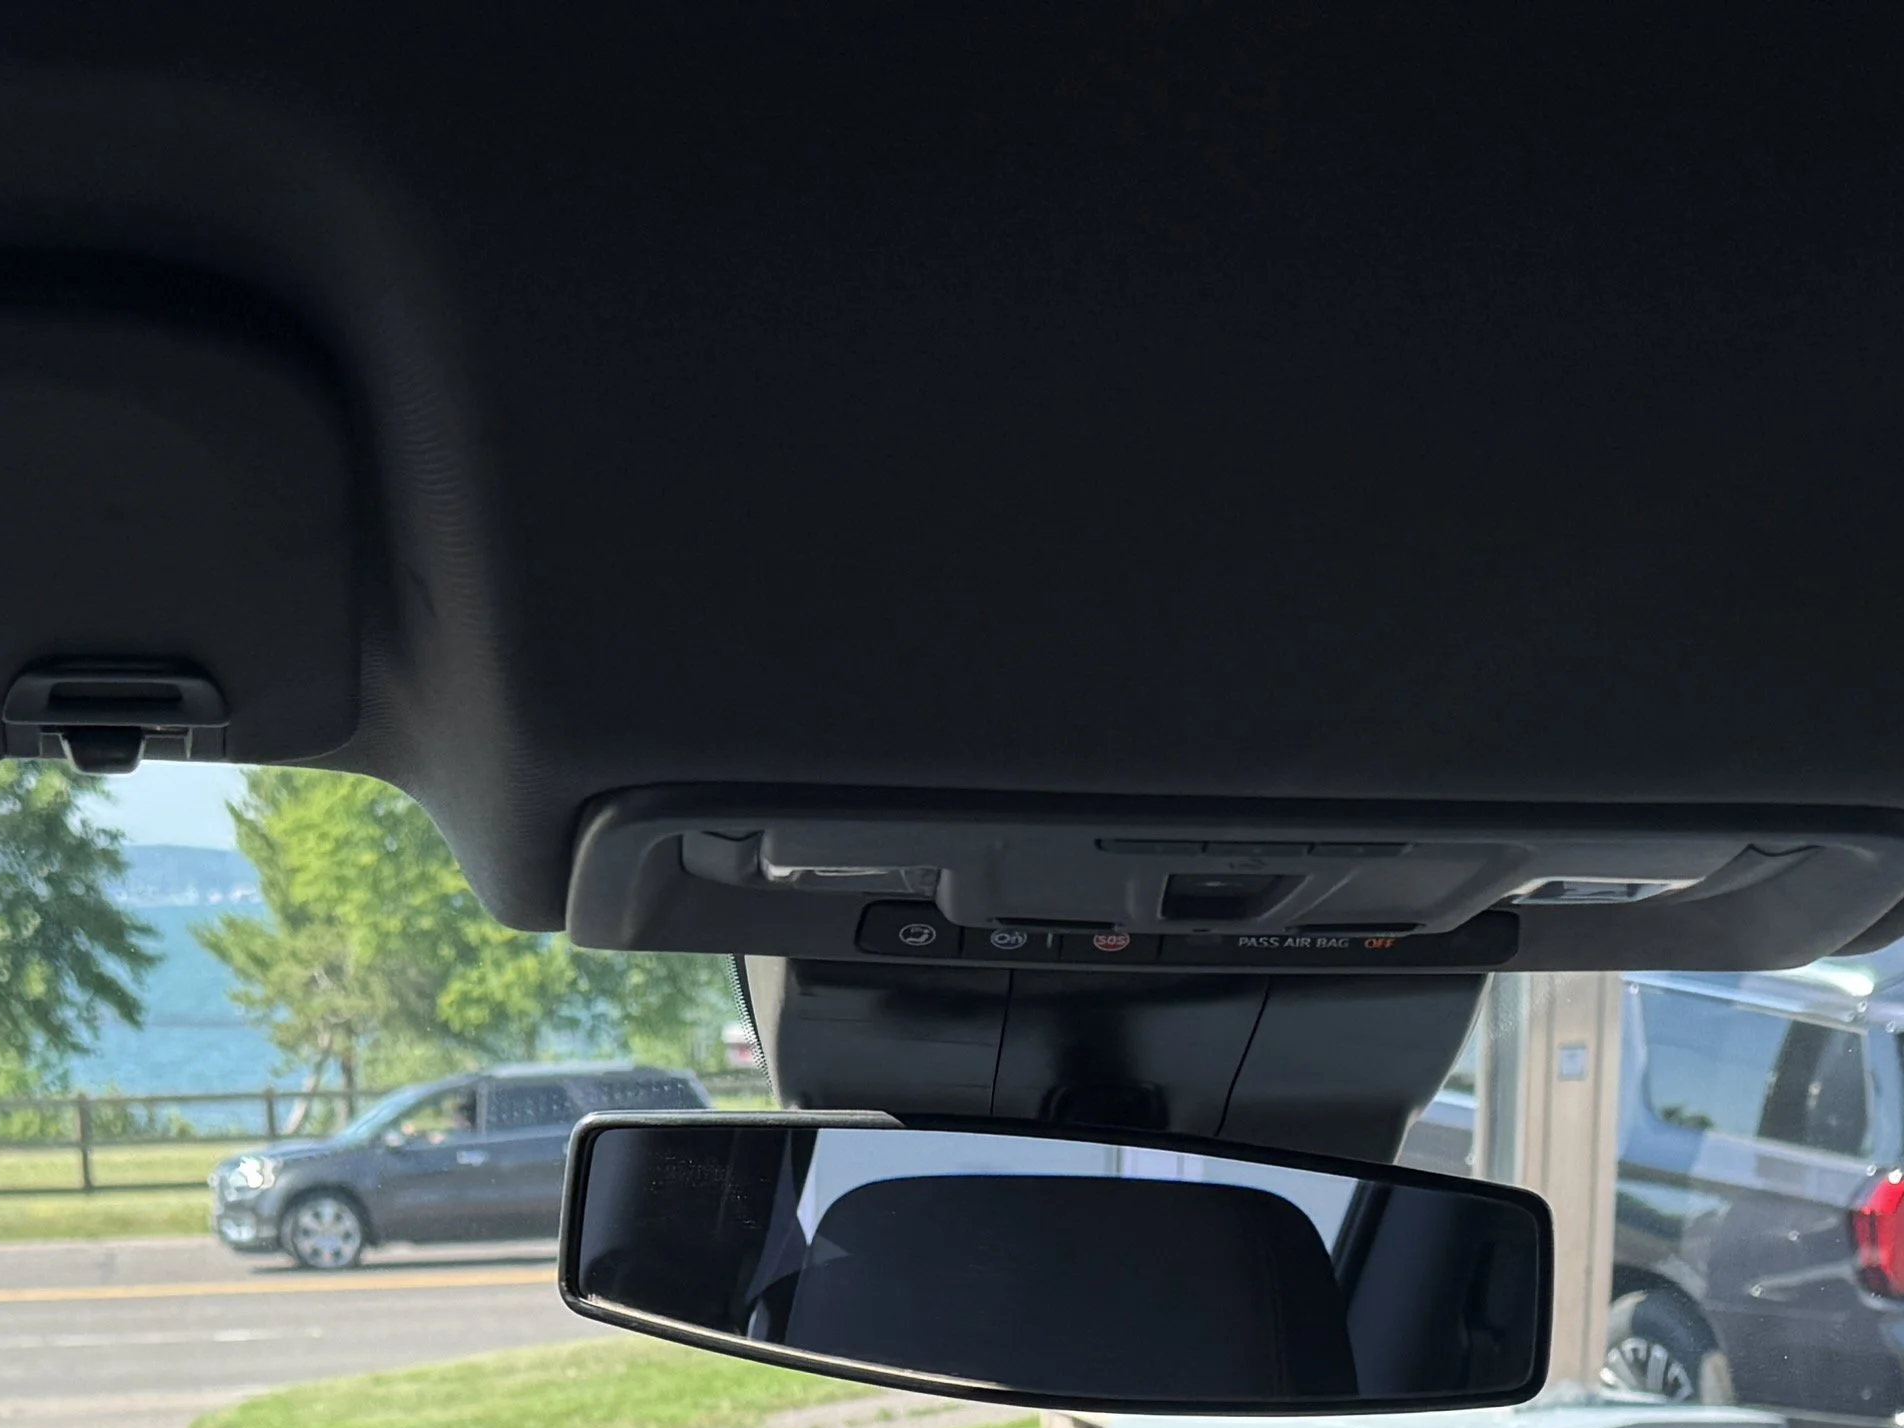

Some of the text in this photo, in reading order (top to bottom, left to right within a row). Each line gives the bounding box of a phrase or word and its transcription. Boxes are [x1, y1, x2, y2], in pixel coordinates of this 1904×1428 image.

[1097, 934, 1126, 946] SOS
[1237, 936, 1396, 950] PASS AIR BAG OFF
